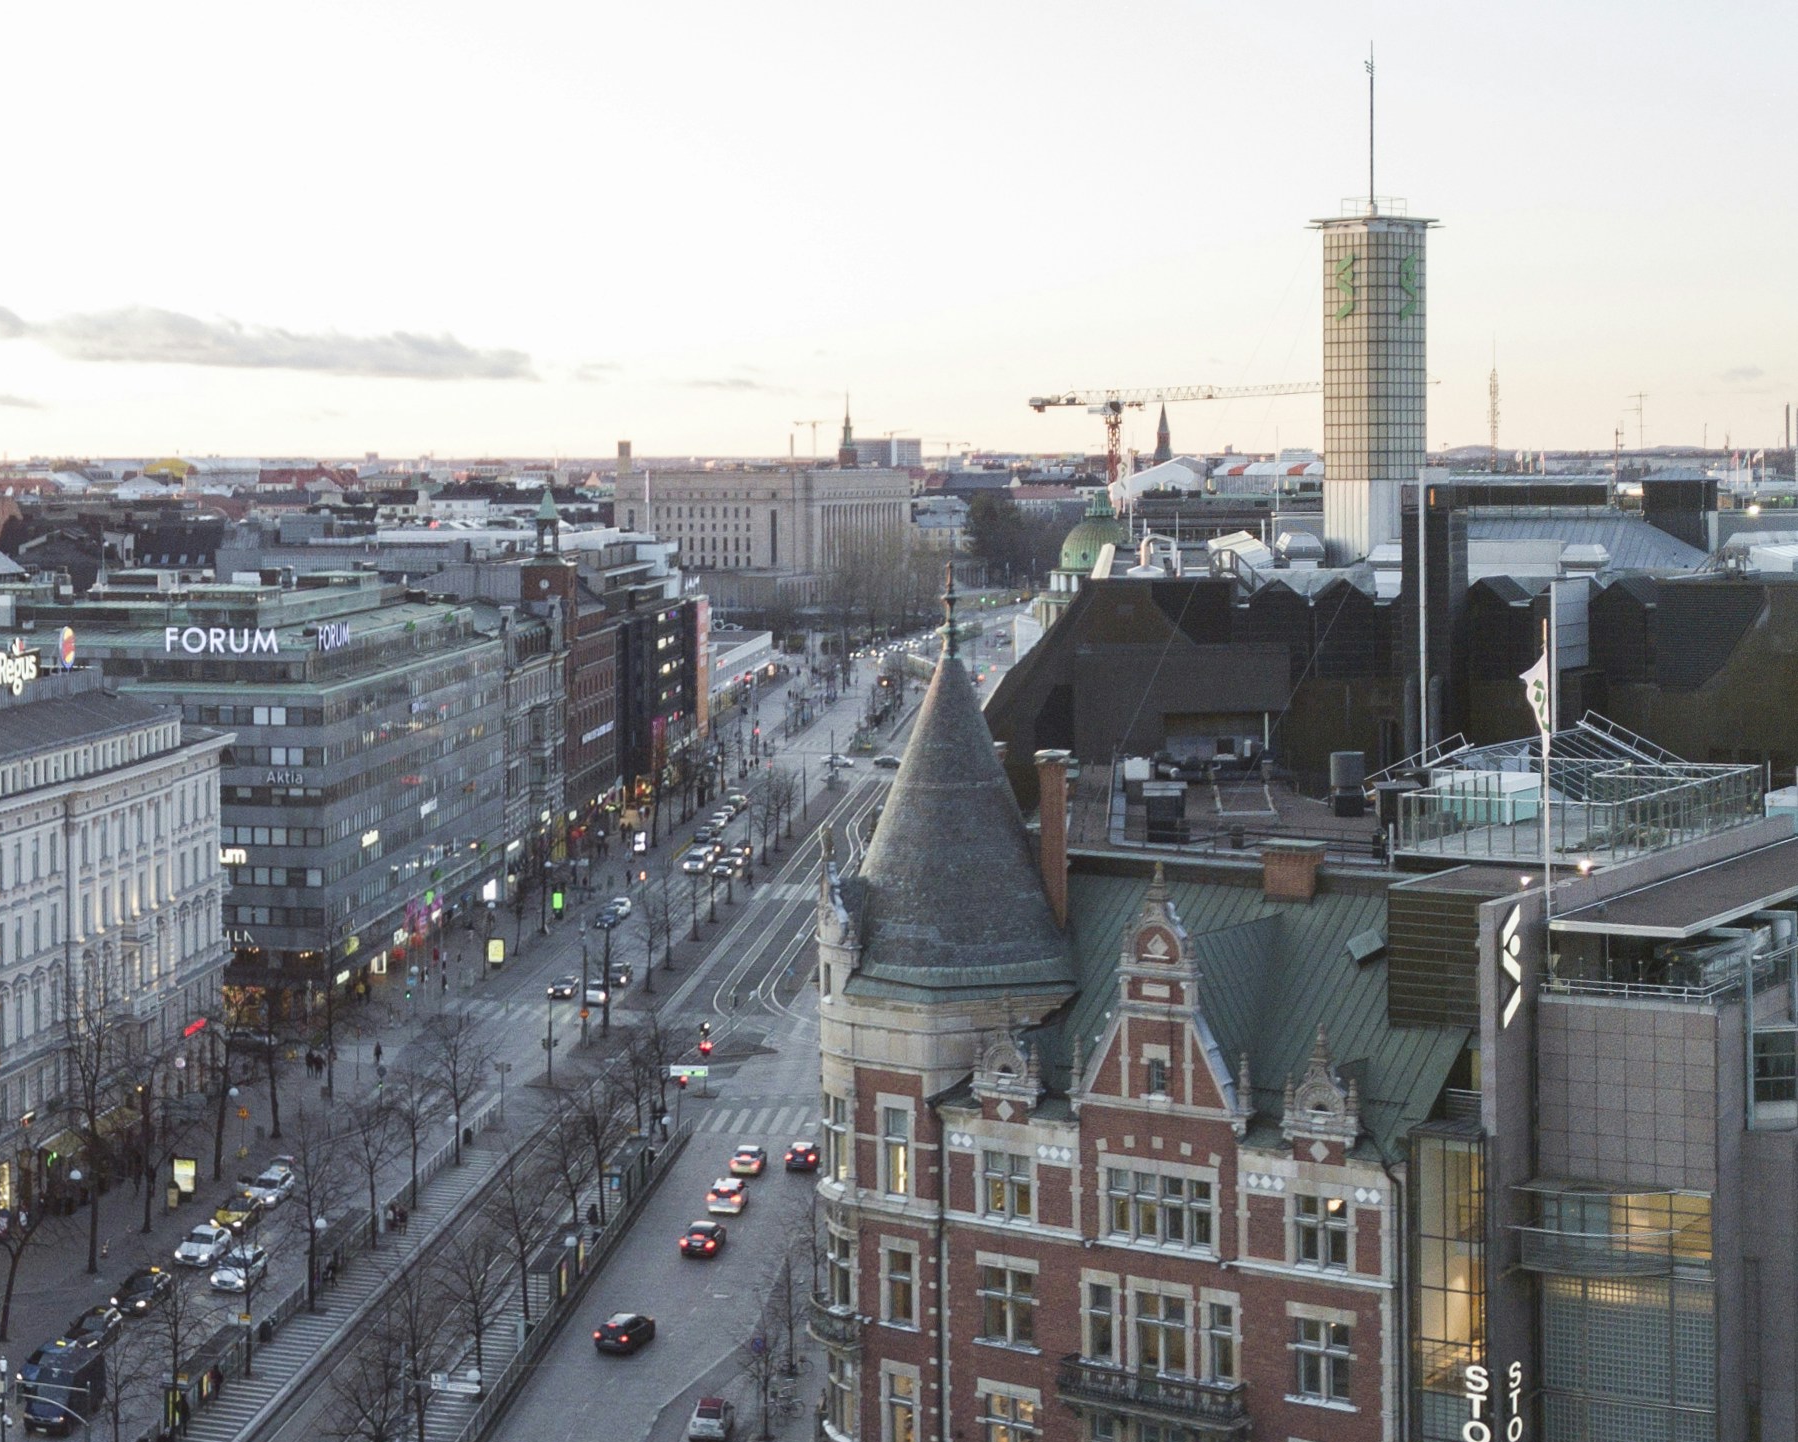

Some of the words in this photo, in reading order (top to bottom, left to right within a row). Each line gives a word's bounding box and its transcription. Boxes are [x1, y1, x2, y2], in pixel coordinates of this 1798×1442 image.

[165, 626, 279, 654] FORUM
[317, 622, 350, 651] FORUM
[266, 771, 304, 784] Aktia
